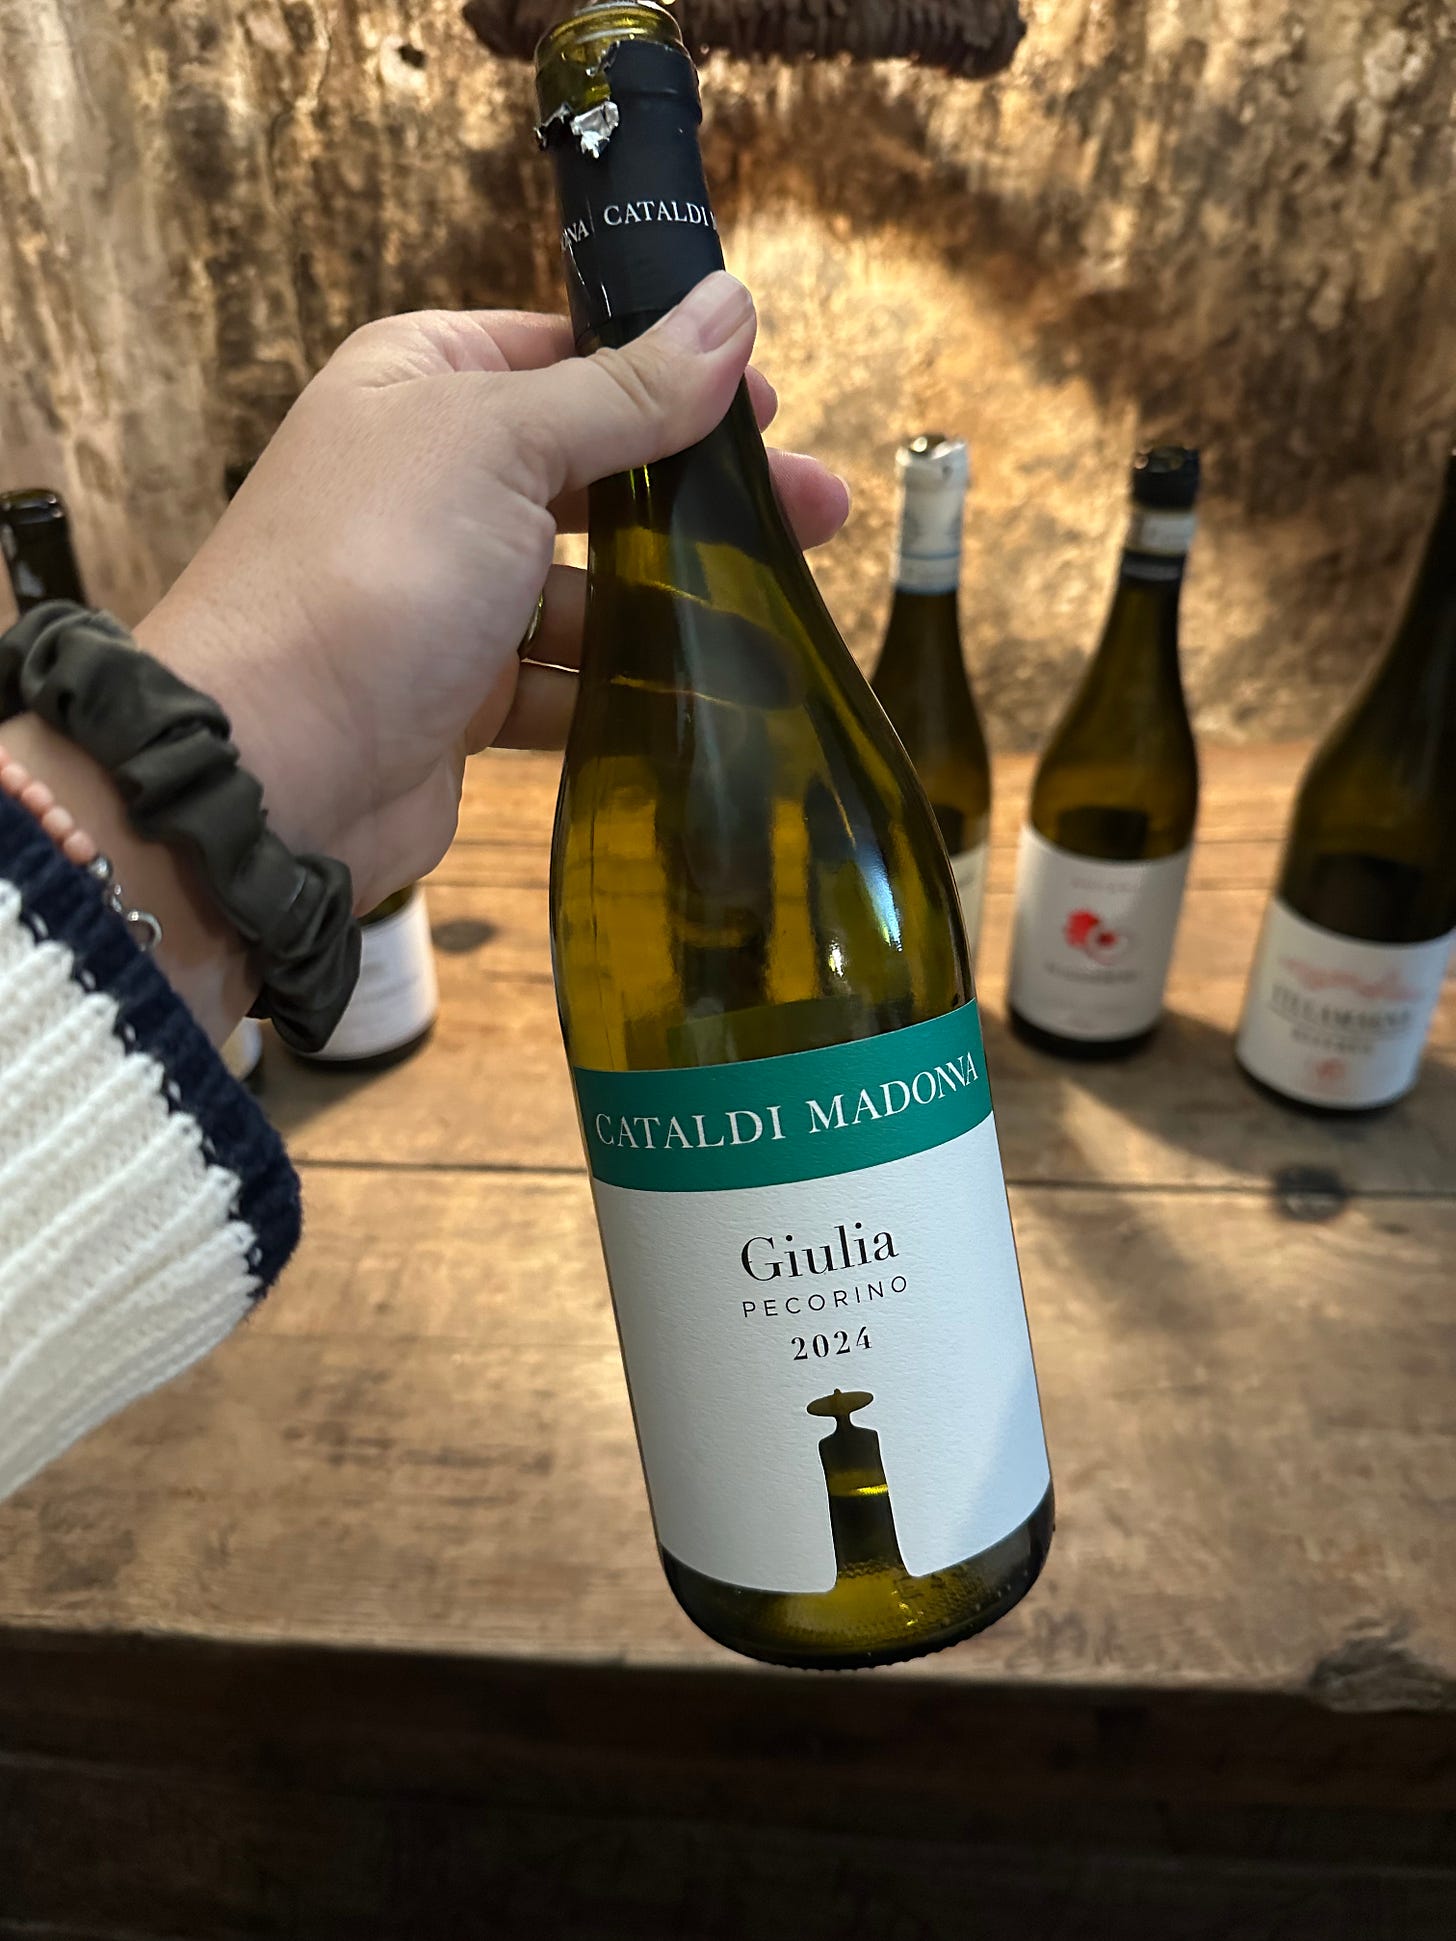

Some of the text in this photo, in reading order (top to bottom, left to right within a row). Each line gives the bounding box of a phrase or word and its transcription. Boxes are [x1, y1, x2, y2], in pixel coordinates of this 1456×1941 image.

[603, 201, 709, 227] CATALDI
[596, 1052, 978, 1149] CATALDI MADONNA
[741, 1222, 899, 1281] Giulia
[742, 1276, 907, 1318] PECORINO
[791, 1326, 872, 1360] 2024
